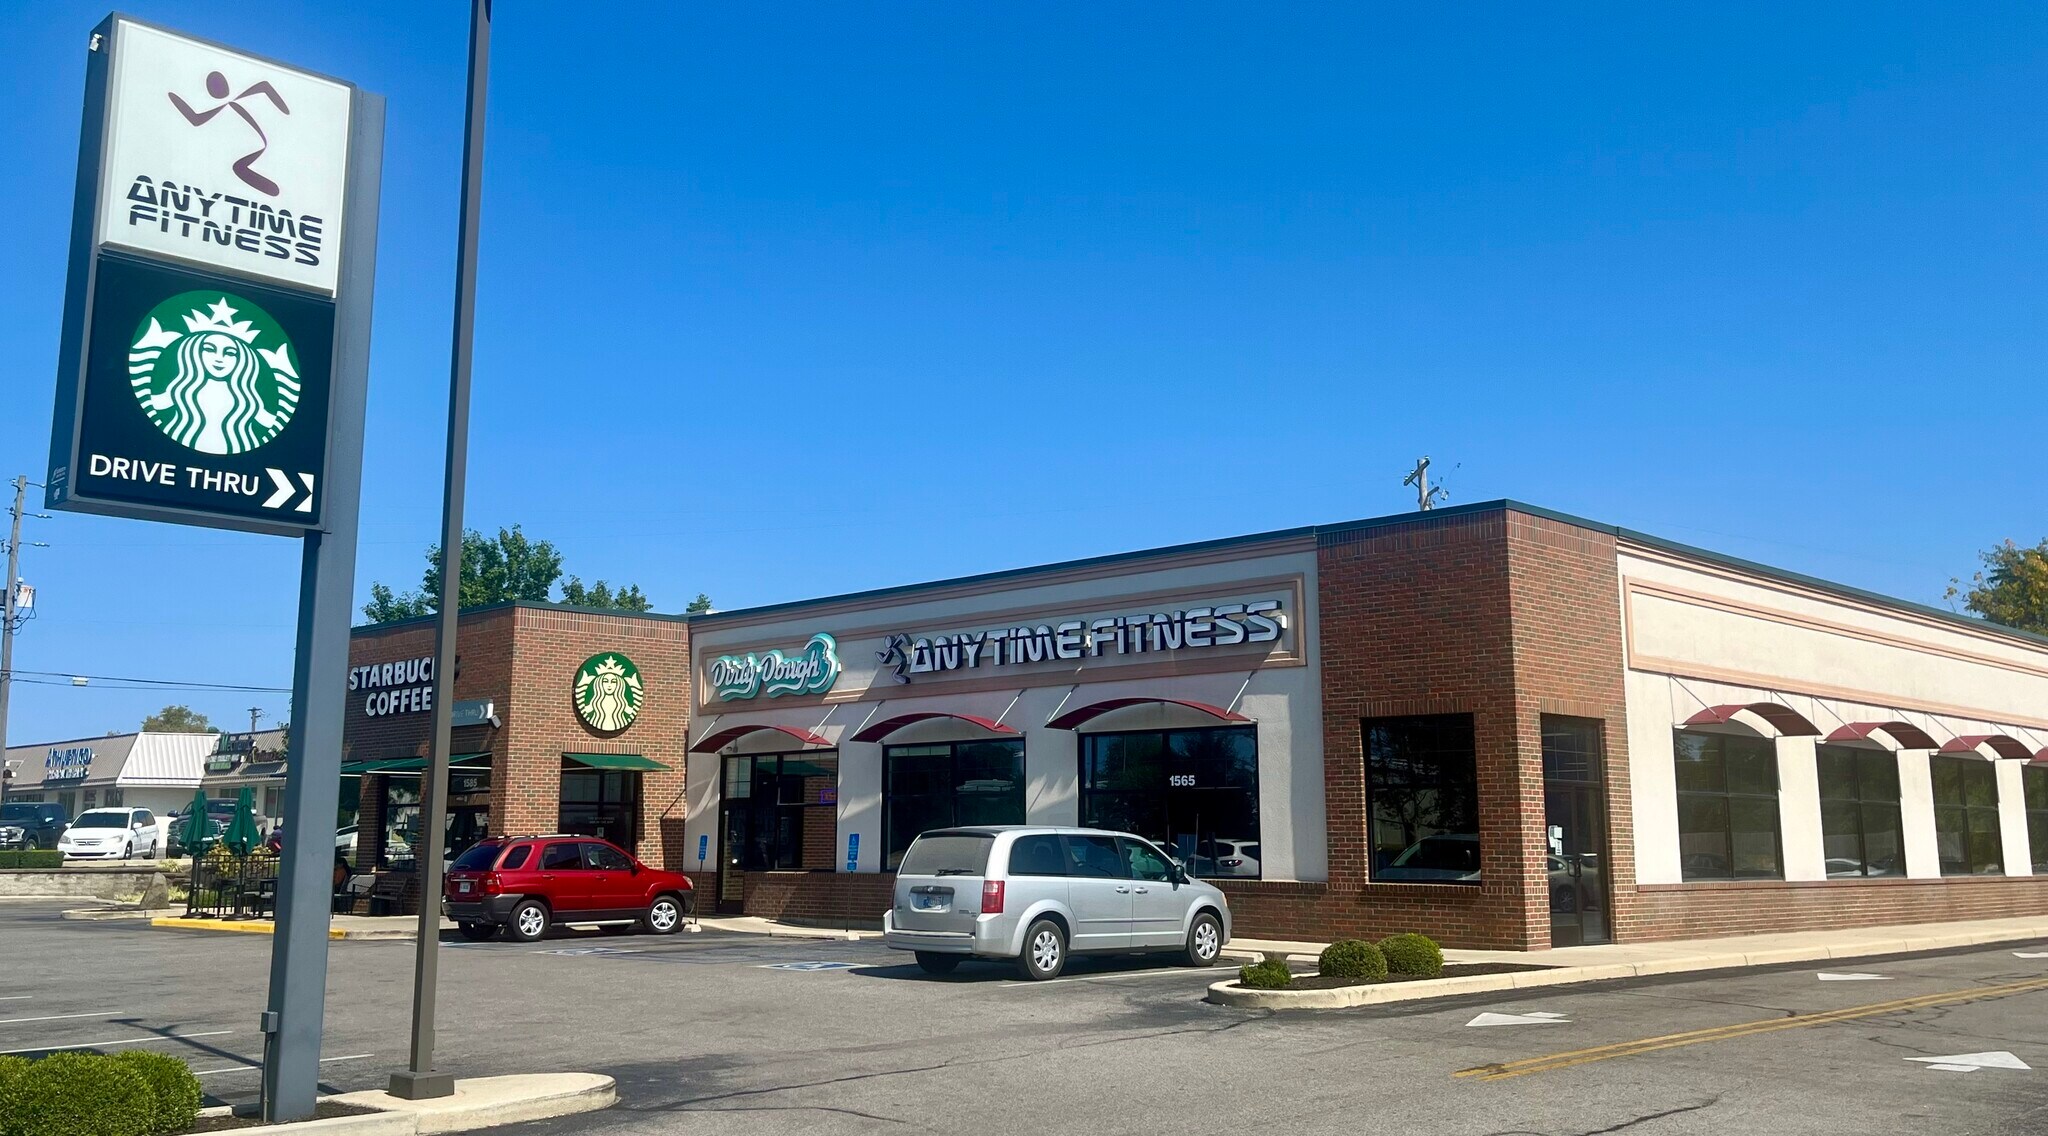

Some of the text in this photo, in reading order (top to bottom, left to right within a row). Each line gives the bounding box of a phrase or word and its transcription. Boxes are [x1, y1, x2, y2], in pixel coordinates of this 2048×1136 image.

[127, 175, 323, 244] ANYTIME
[129, 204, 321, 266] FITNESS
[89, 453, 176, 486] DRIVE
[185, 466, 260, 496] THRU
[909, 600, 1282, 674] ANYTIME FITNESS
[349, 656, 435, 690] STARBUC
[710, 649, 820, 697] Dirty Dough
[365, 686, 433, 717] COFFEE
[463, 778, 478, 788] 1585
[1169, 774, 1196, 787] 1565
